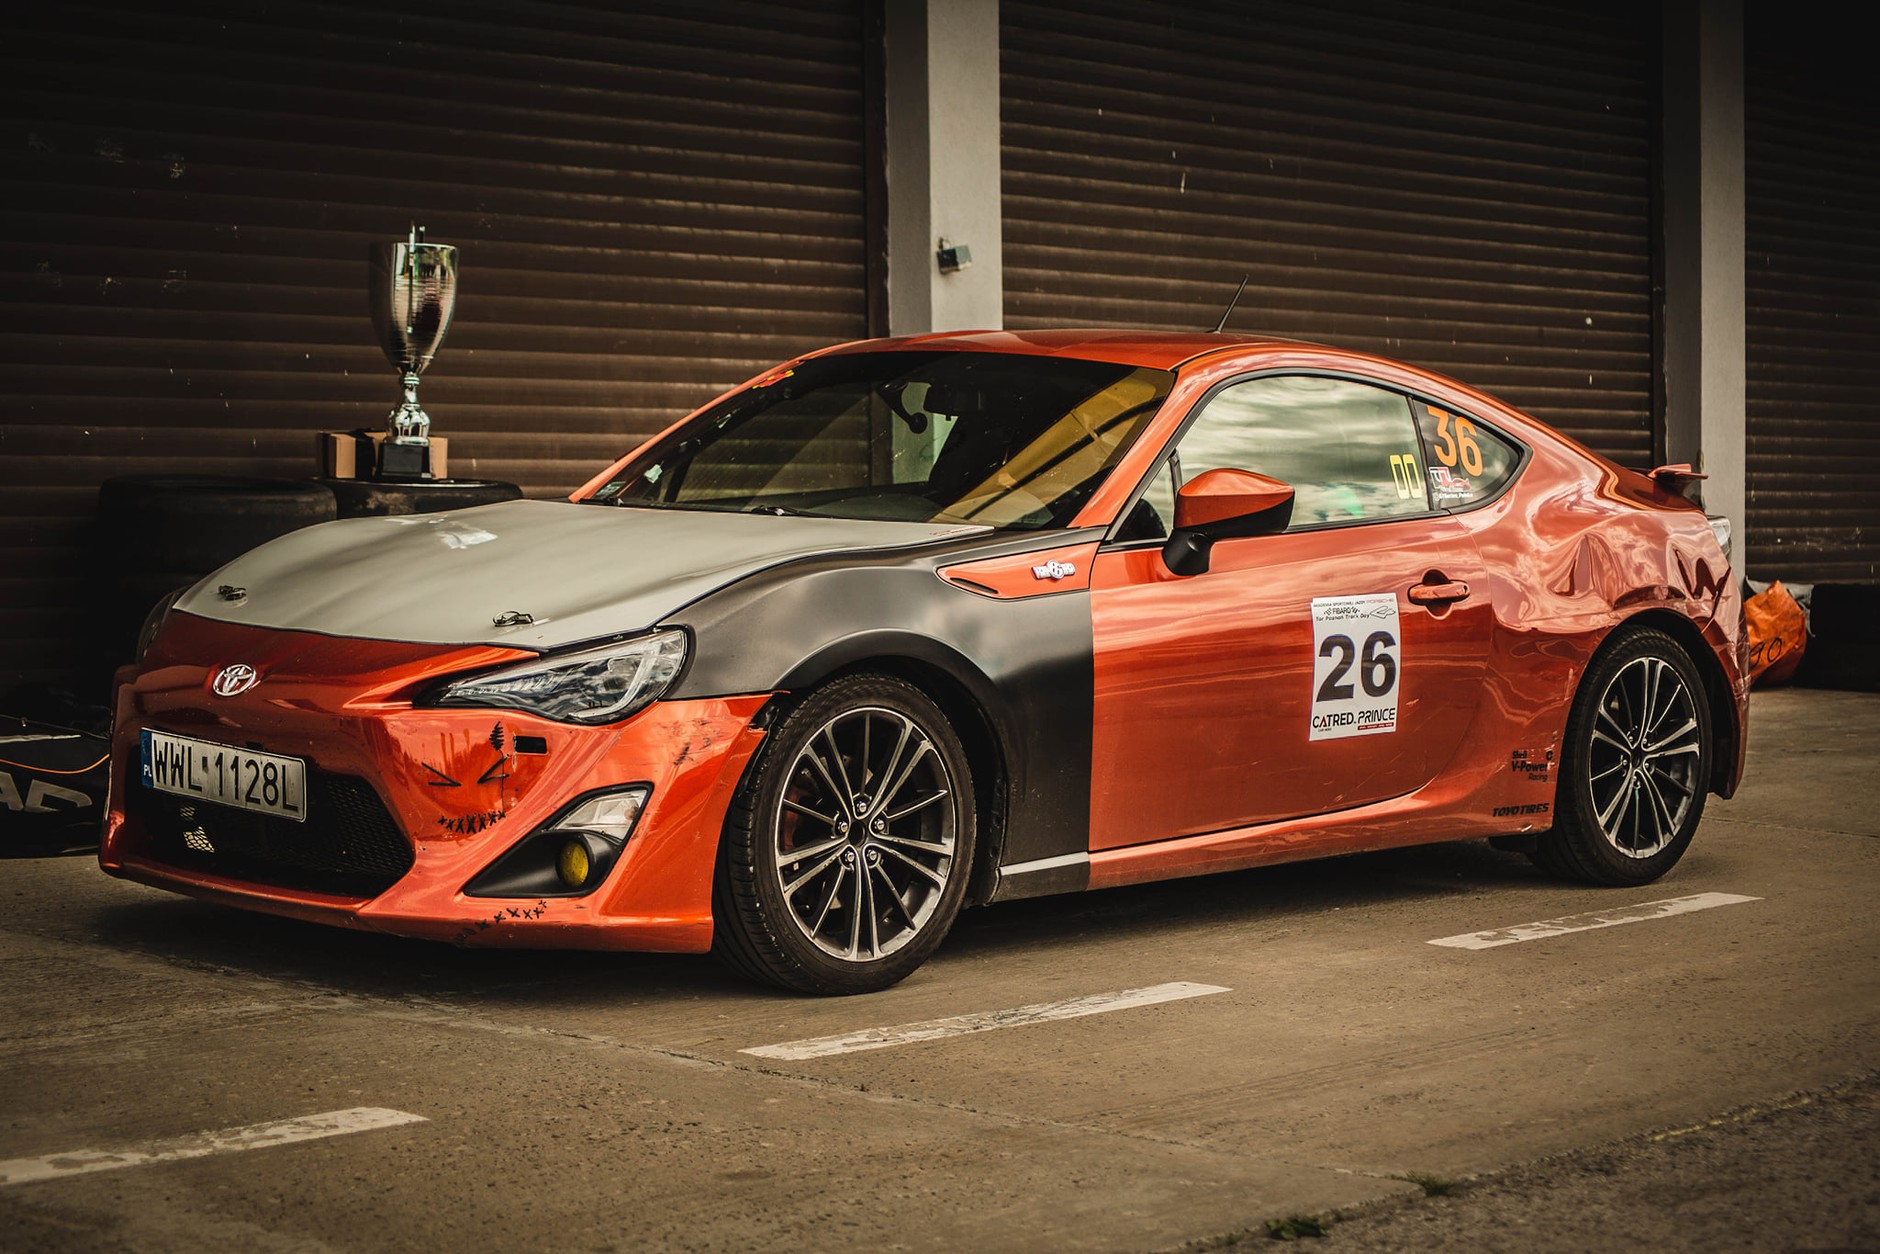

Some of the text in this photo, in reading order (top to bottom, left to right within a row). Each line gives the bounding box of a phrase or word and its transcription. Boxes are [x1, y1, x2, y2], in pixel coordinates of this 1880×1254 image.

[1426, 405, 1483, 477] 36
[1332, 606, 1351, 615] FIBARO
[1316, 631, 1396, 702] 26
[1357, 707, 1396, 724] PRINCE
[143, 764, 153, 777] PL
[1512, 761, 1548, 772] V-Power
[153, 740, 299, 812] WWL 1128L
[1528, 773, 1548, 782] Racing
[1493, 803, 1550, 817] TOYO TIRES
